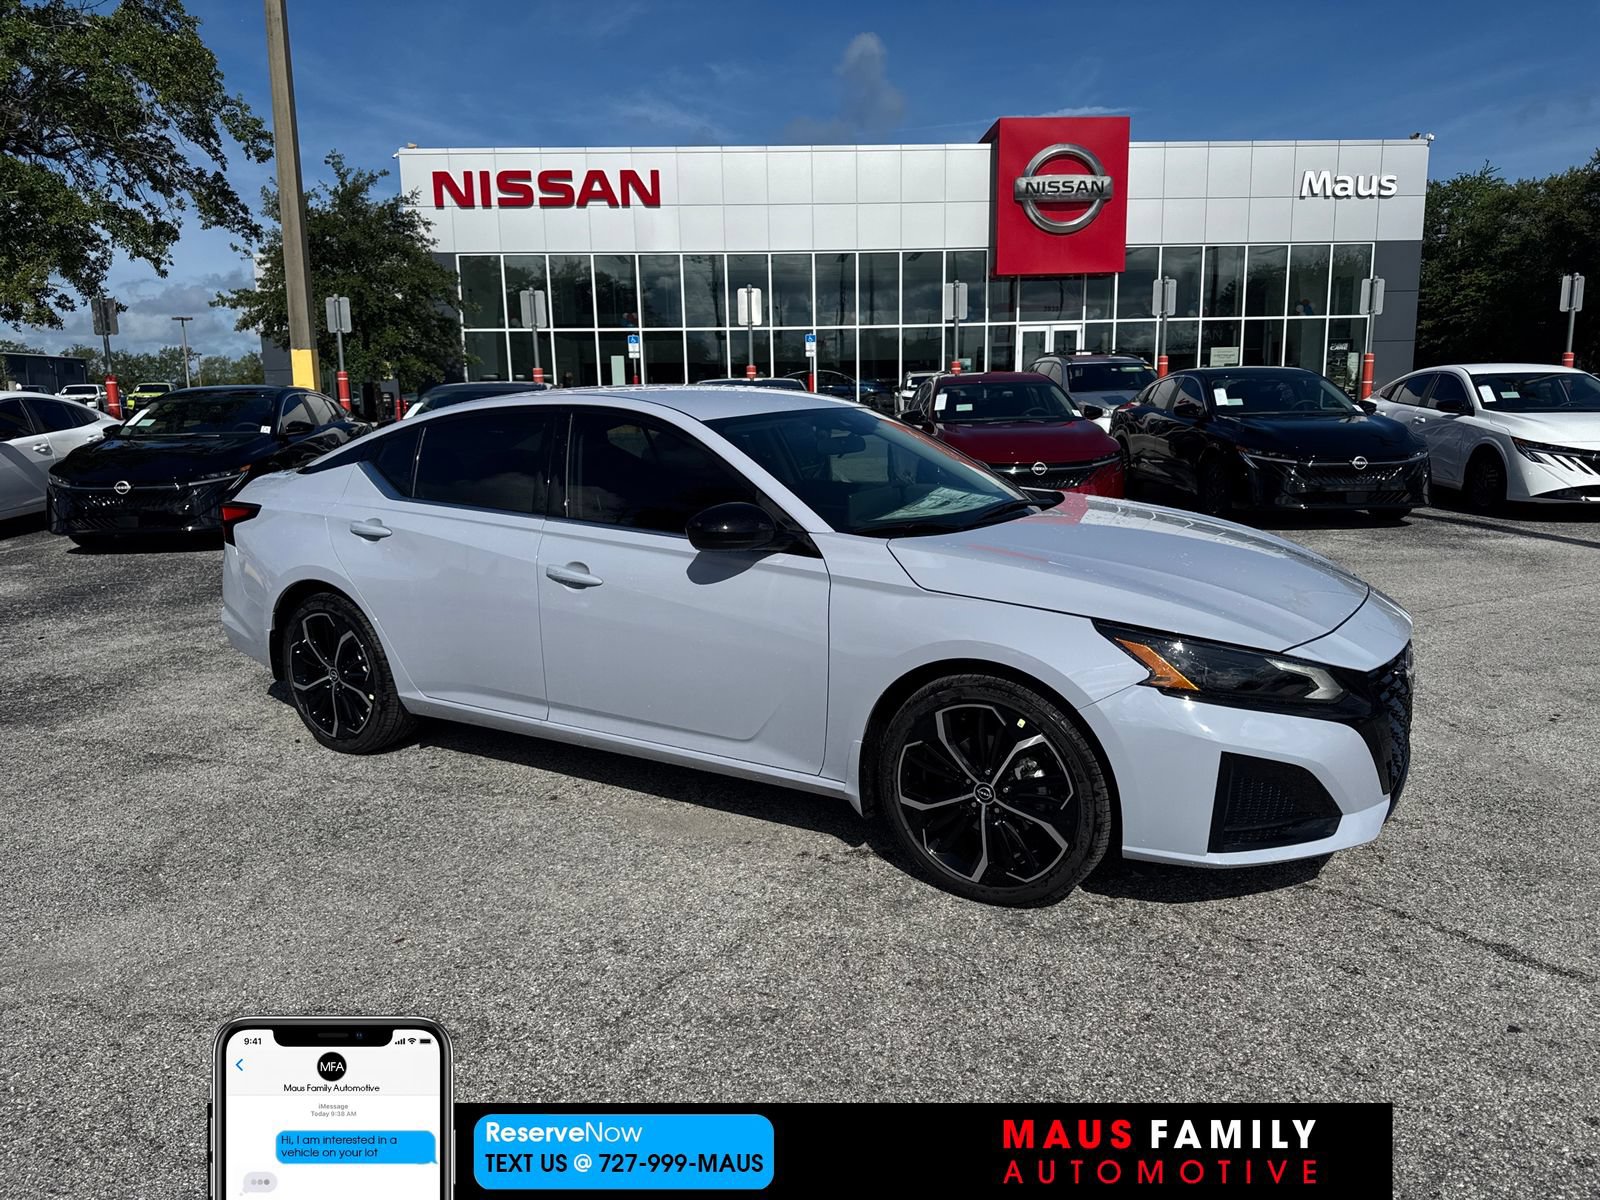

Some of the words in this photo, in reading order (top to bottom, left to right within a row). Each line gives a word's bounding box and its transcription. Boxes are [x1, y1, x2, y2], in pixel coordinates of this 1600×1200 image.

[432, 169, 661, 209] NISSAN
[1025, 180, 1104, 194] NISSAN
[1299, 169, 1398, 200] Maus
